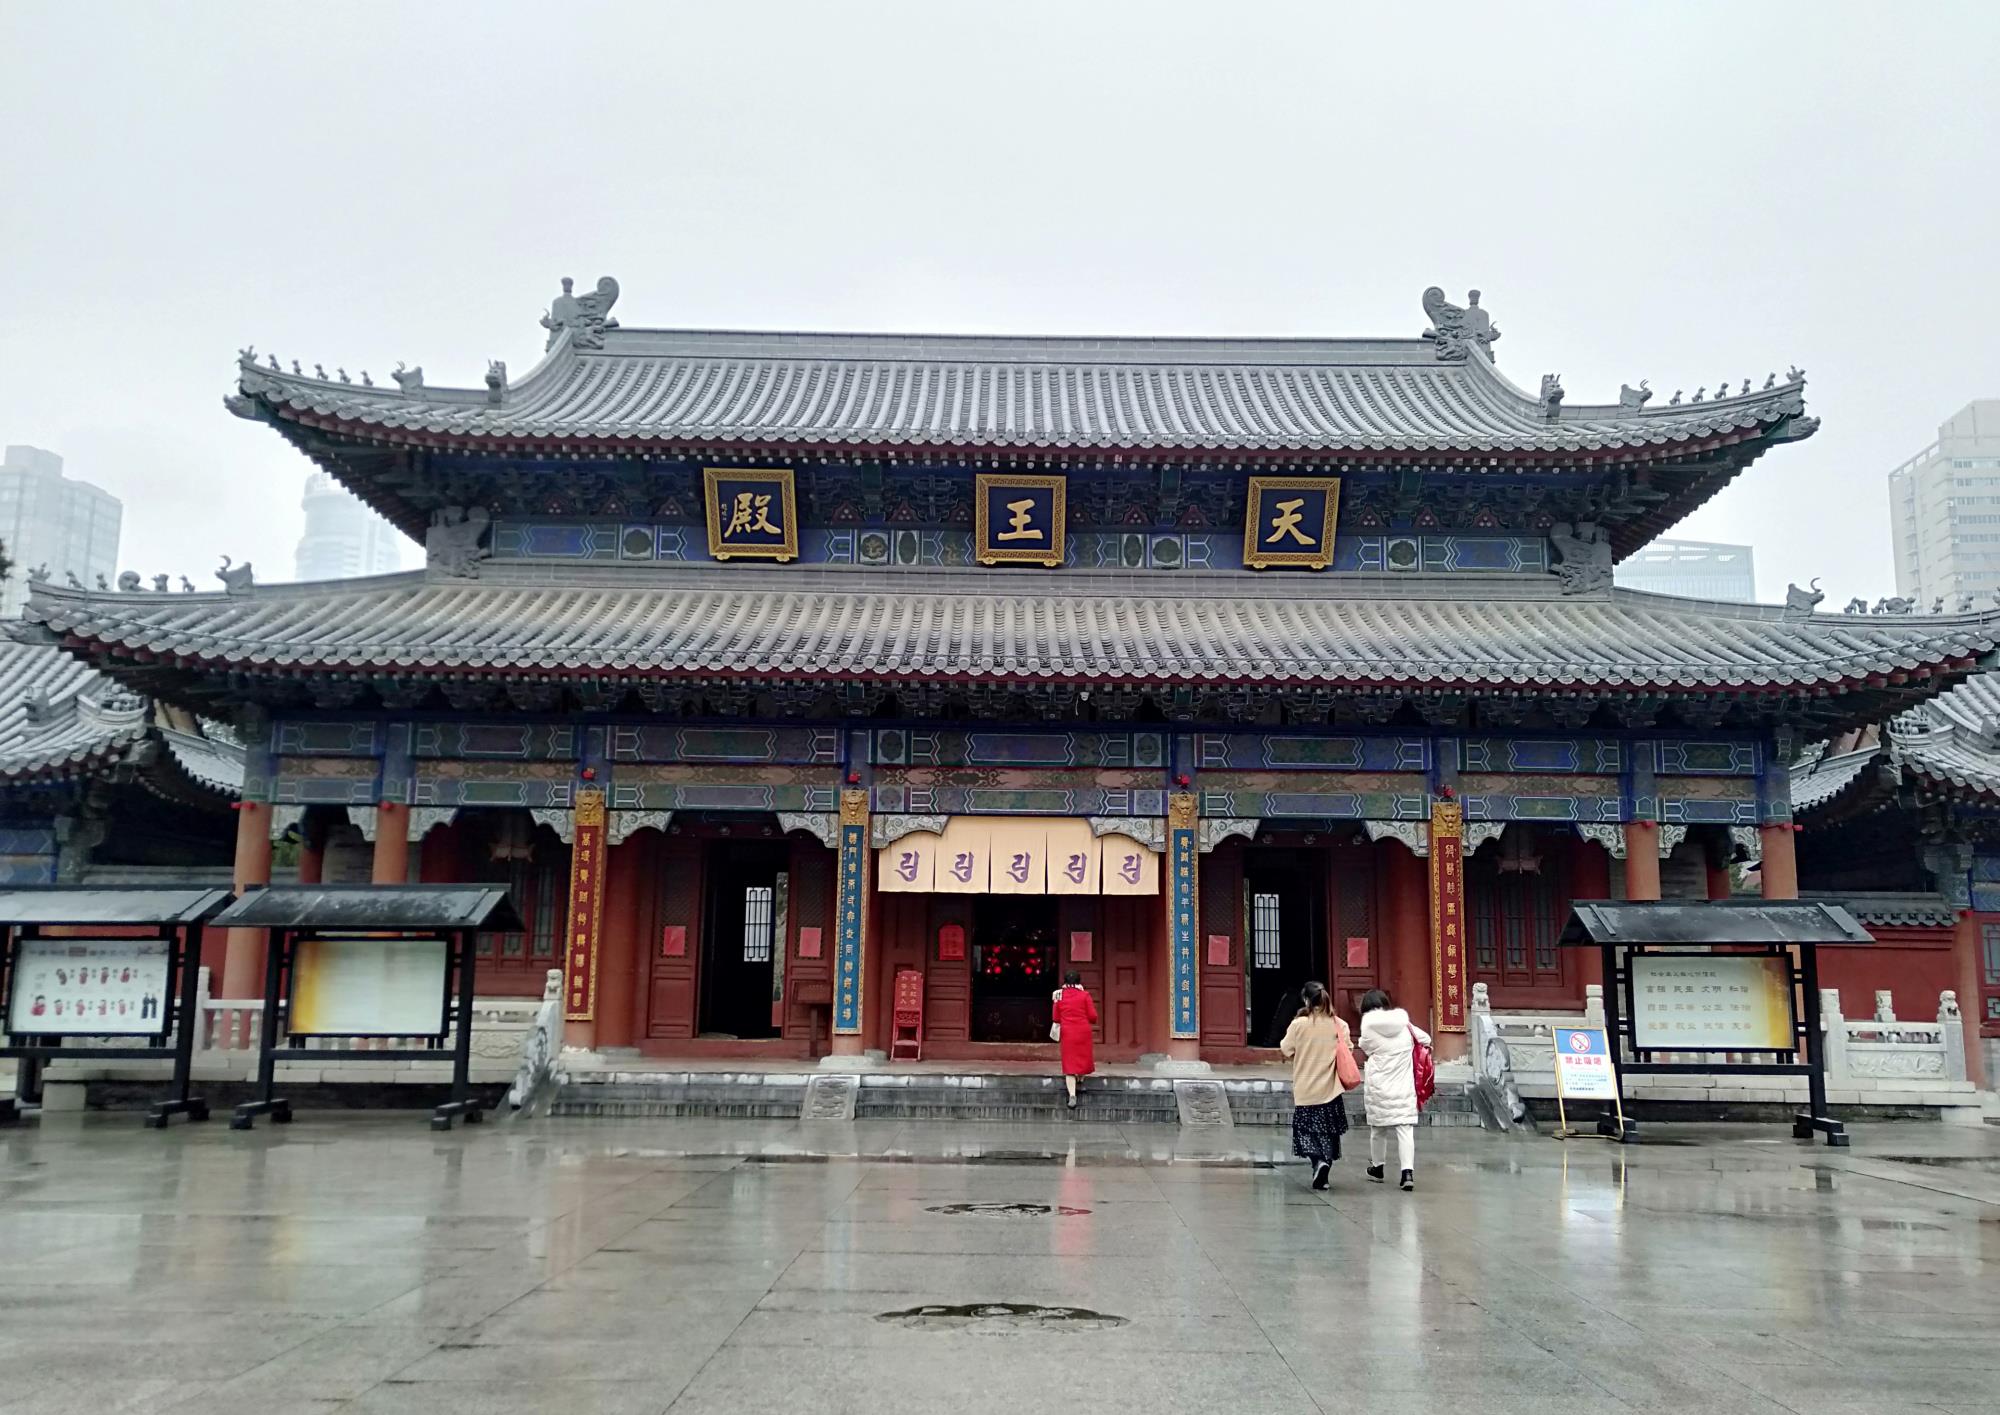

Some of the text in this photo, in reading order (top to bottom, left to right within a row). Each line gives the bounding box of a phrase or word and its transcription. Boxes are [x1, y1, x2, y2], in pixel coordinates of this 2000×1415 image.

[724, 493, 782, 538] 殿
[997, 498, 1044, 541] 王
[1265, 498, 1317, 545] 天
[1674, 985, 1694, 993] 民主
[1701, 985, 1722, 993] 文明
[1565, 1056, 1602, 1066] 禁止吸烟
